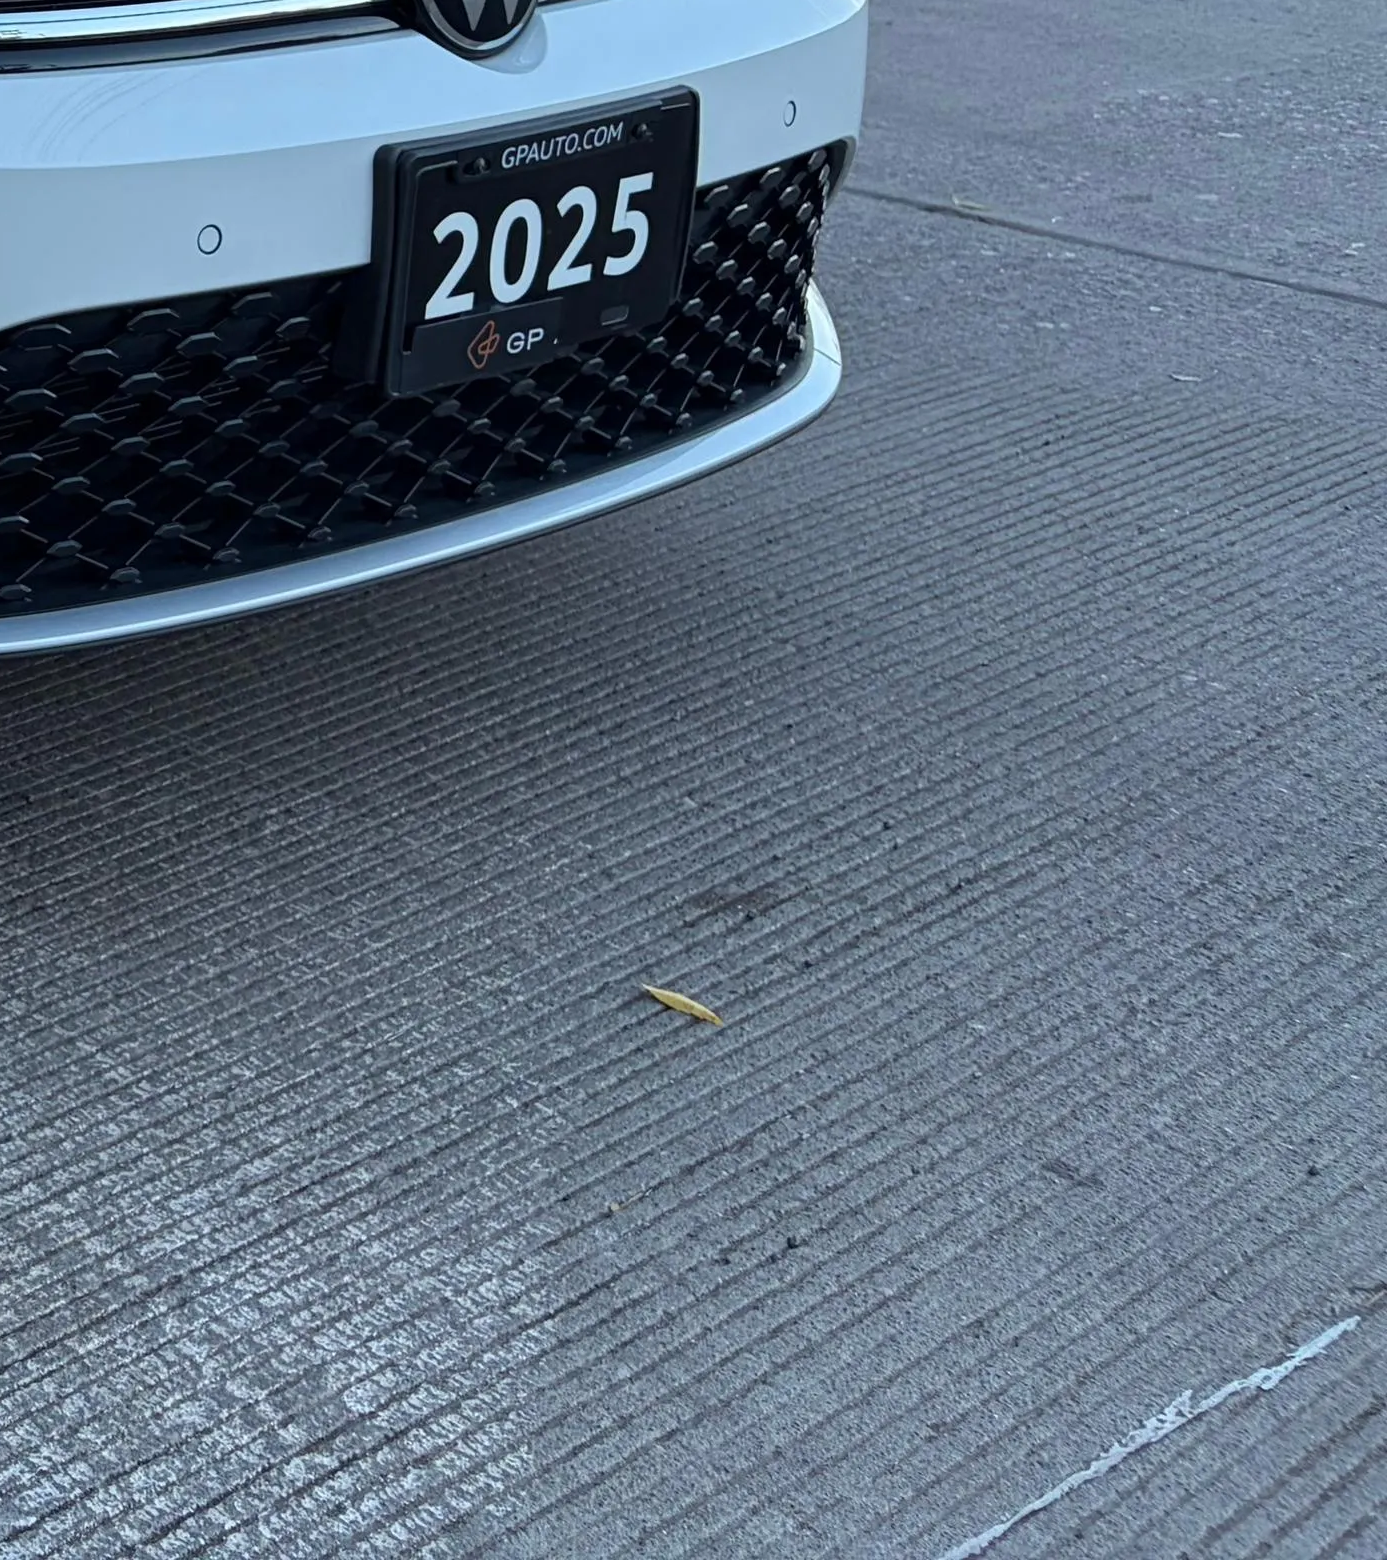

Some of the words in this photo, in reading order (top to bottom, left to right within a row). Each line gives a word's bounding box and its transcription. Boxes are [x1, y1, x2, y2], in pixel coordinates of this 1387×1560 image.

[500, 121, 624, 169] GPAUTO.COM
[424, 171, 655, 321] 2025
[506, 327, 545, 354] GP
